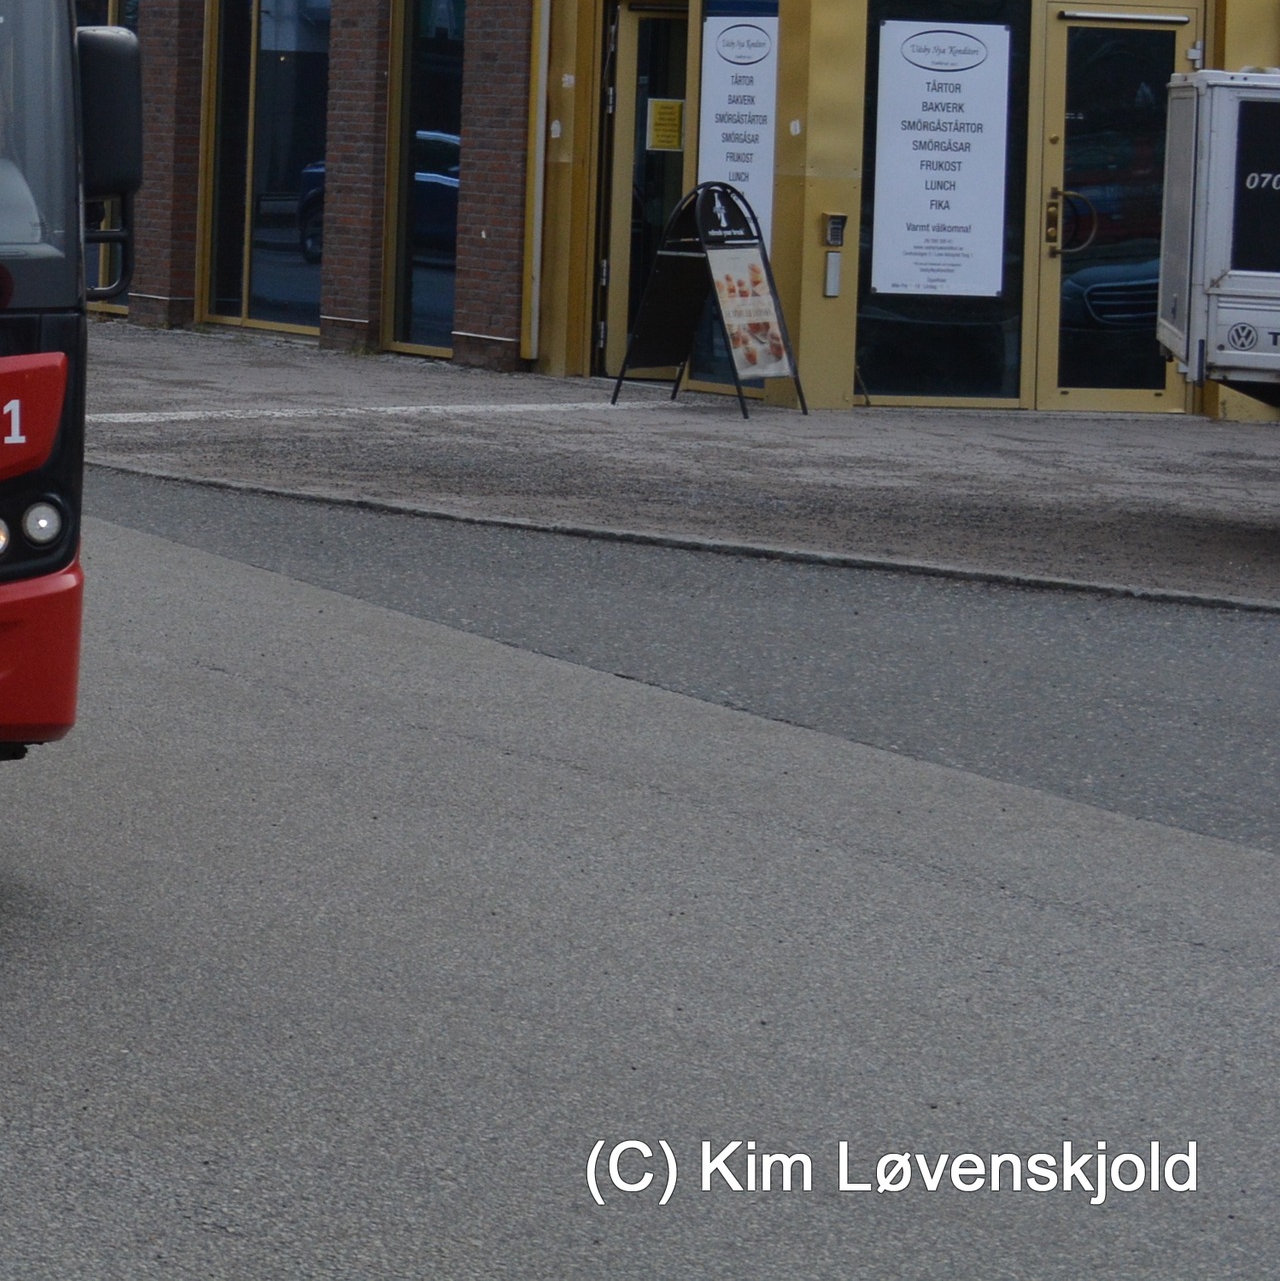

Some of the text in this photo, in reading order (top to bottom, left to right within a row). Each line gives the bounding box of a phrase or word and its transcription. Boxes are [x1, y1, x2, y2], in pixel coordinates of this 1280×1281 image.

[925, 79, 962, 94] TÅRTOR
[727, 94, 756, 106] BAKVERK
[921, 101, 965, 113] BAKVERK
[900, 119, 984, 134] SMÖRGÅSTÅRTOR
[912, 139, 972, 153] SMÖRGÅSAR
[725, 151, 754, 163] FRUKOST
[919, 160, 963, 172] FRUKOST
[728, 171, 750, 183] LUNCH
[925, 179, 956, 191] LUNCH
[929, 199, 951, 211] FIKA
[905, 222, 930, 232] Varmt
